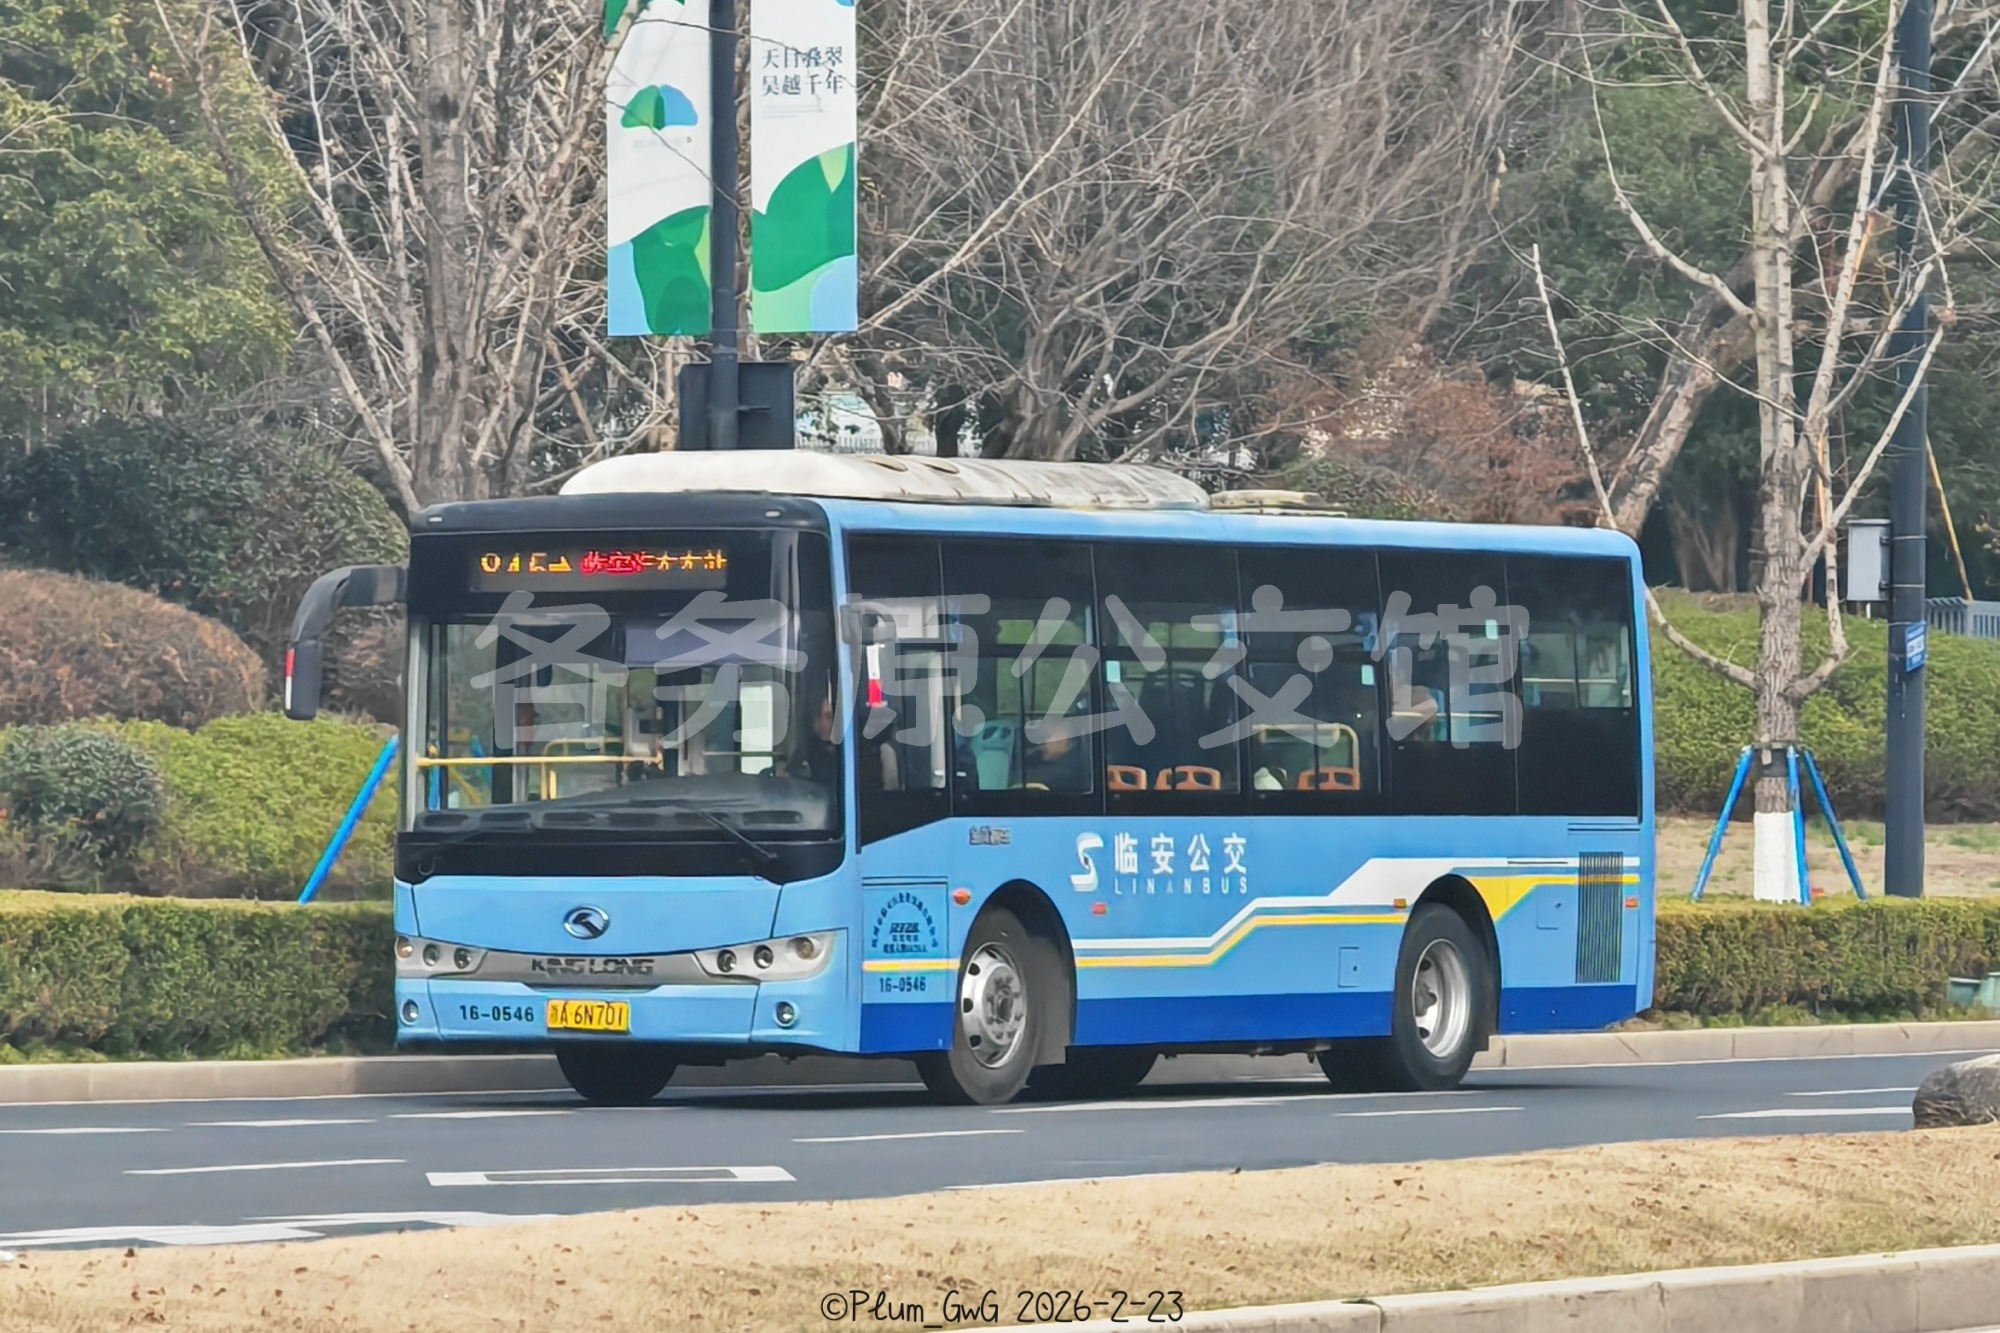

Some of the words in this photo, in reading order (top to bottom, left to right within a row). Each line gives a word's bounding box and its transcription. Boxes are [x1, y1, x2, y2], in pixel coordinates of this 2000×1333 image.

[762, 70, 845, 96] 吴越千年
[1114, 832, 1247, 875] 临安公交
[531, 958, 588, 975] KING
[589, 958, 654, 976] LONG
[879, 976, 926, 992] 16-0546
[459, 1004, 535, 1023] 16-0546
